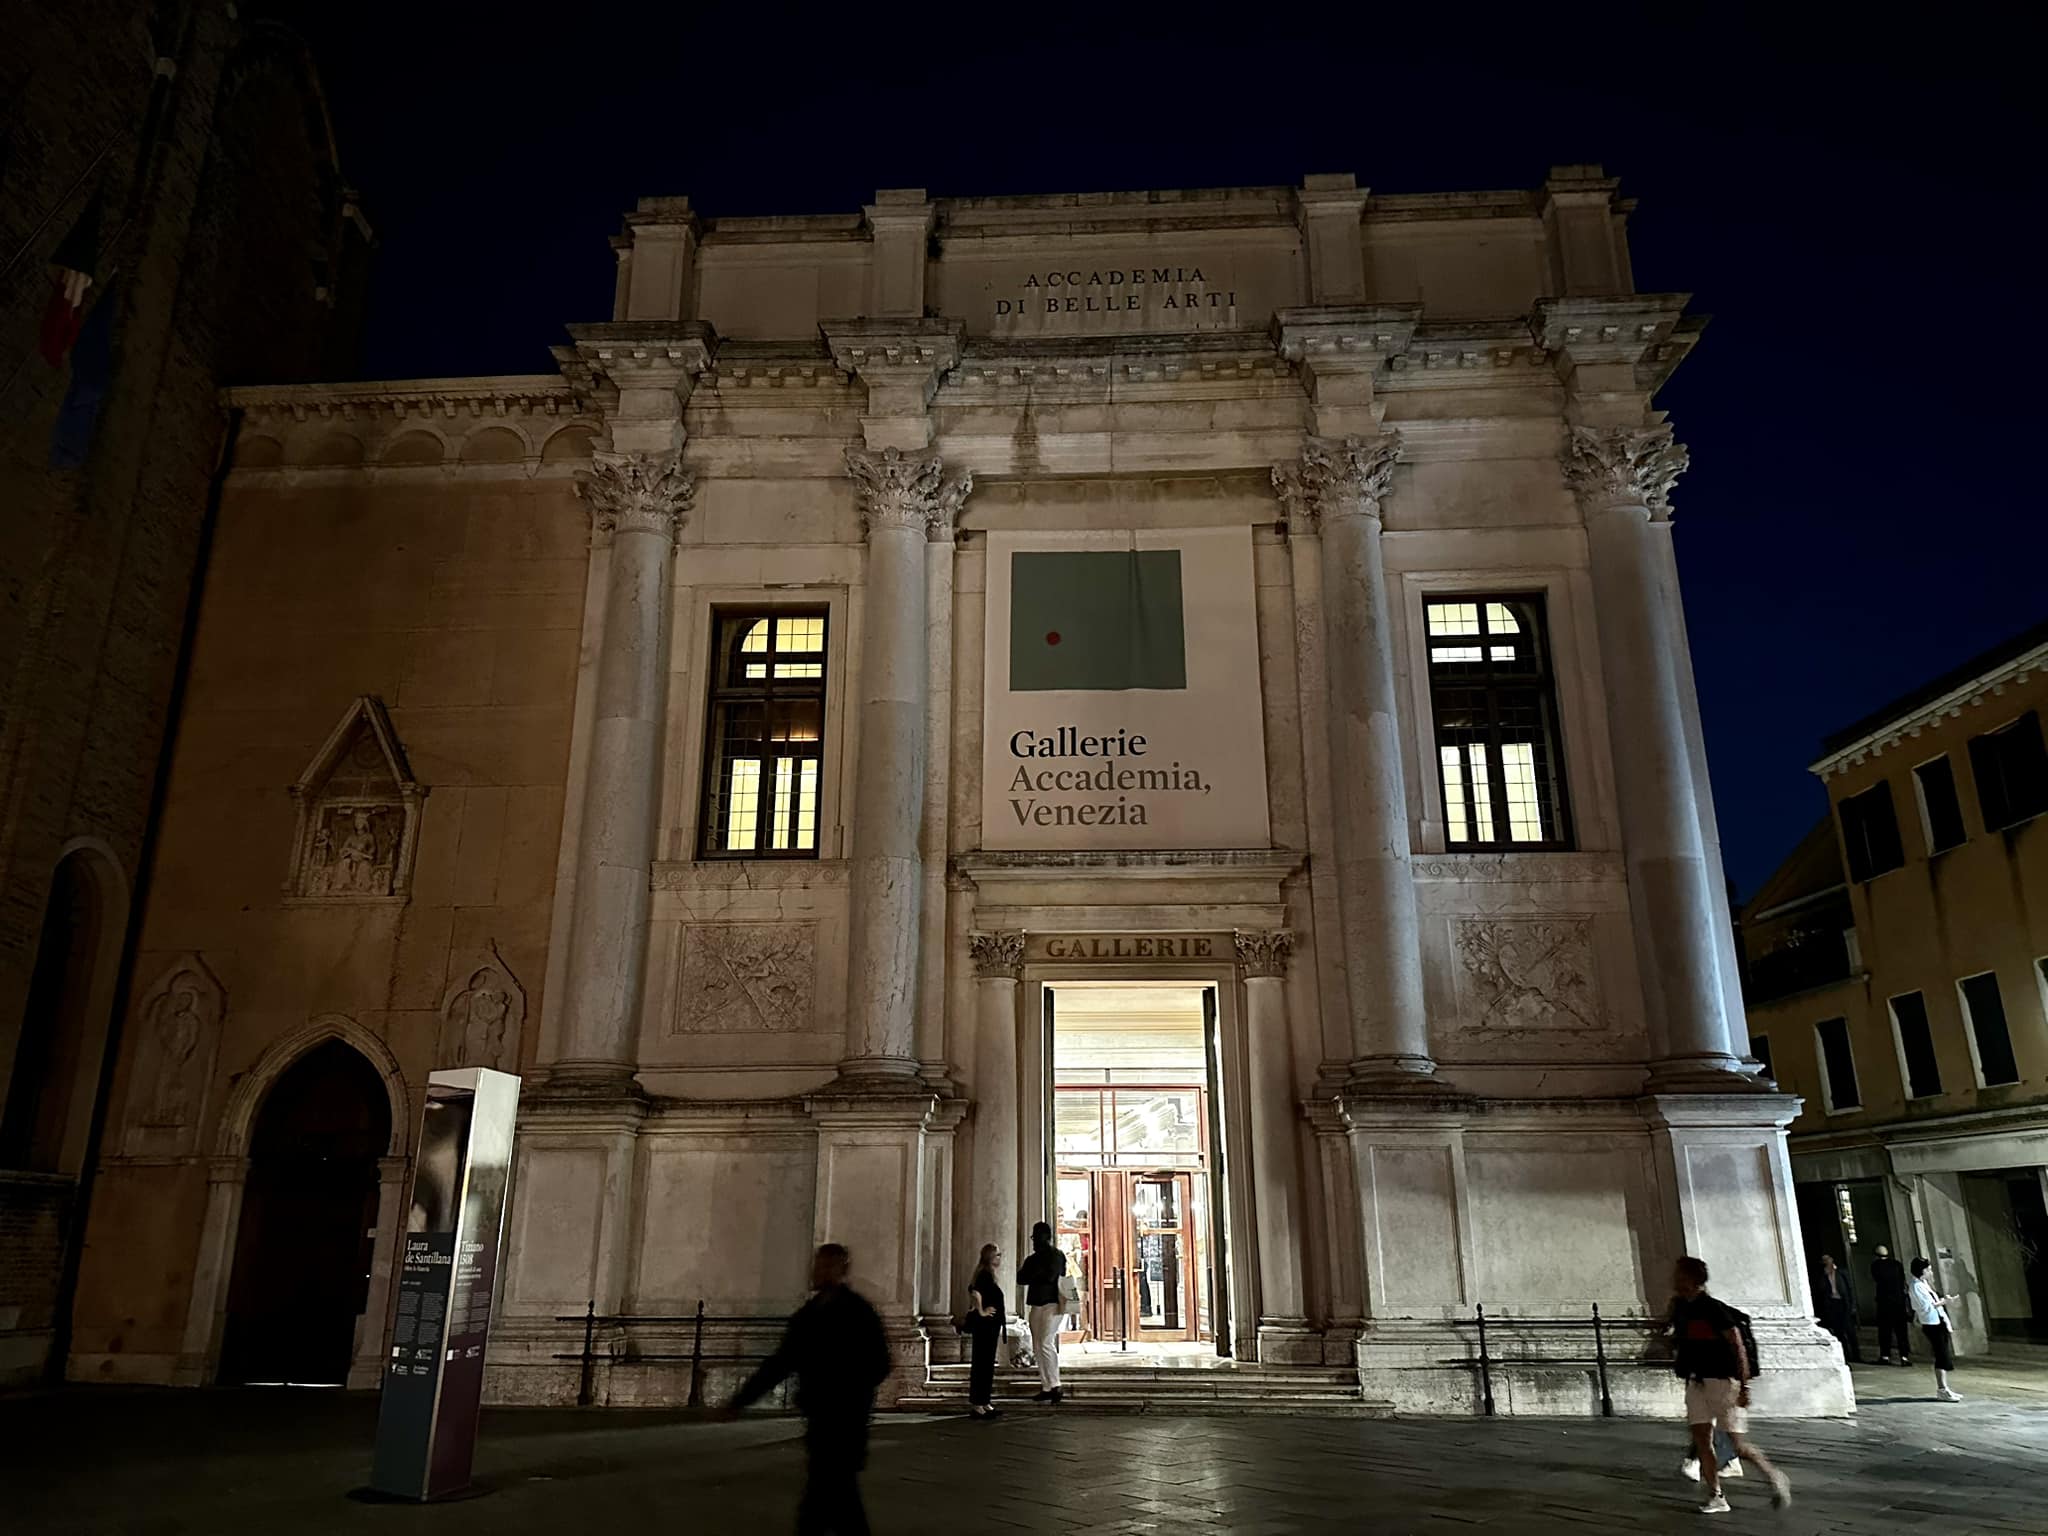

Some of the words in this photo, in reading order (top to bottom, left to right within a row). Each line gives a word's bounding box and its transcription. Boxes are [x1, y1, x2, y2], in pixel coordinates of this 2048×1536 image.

[1024, 268, 1206, 287] ACCADEMIA
[996, 299, 1026, 315] DI
[1046, 295, 1141, 313] BELLE
[1163, 292, 1237, 309] ARTI
[1009, 727, 1147, 758] Gallerie
[1008, 761, 1212, 795] Accademia,
[1008, 796, 1148, 827] Venezia
[1046, 938, 1212, 957] GALLERIE
[407, 1239, 429, 1251] Laura
[404, 1251, 414, 1264] de
[415, 1251, 451, 1265] Santillana
